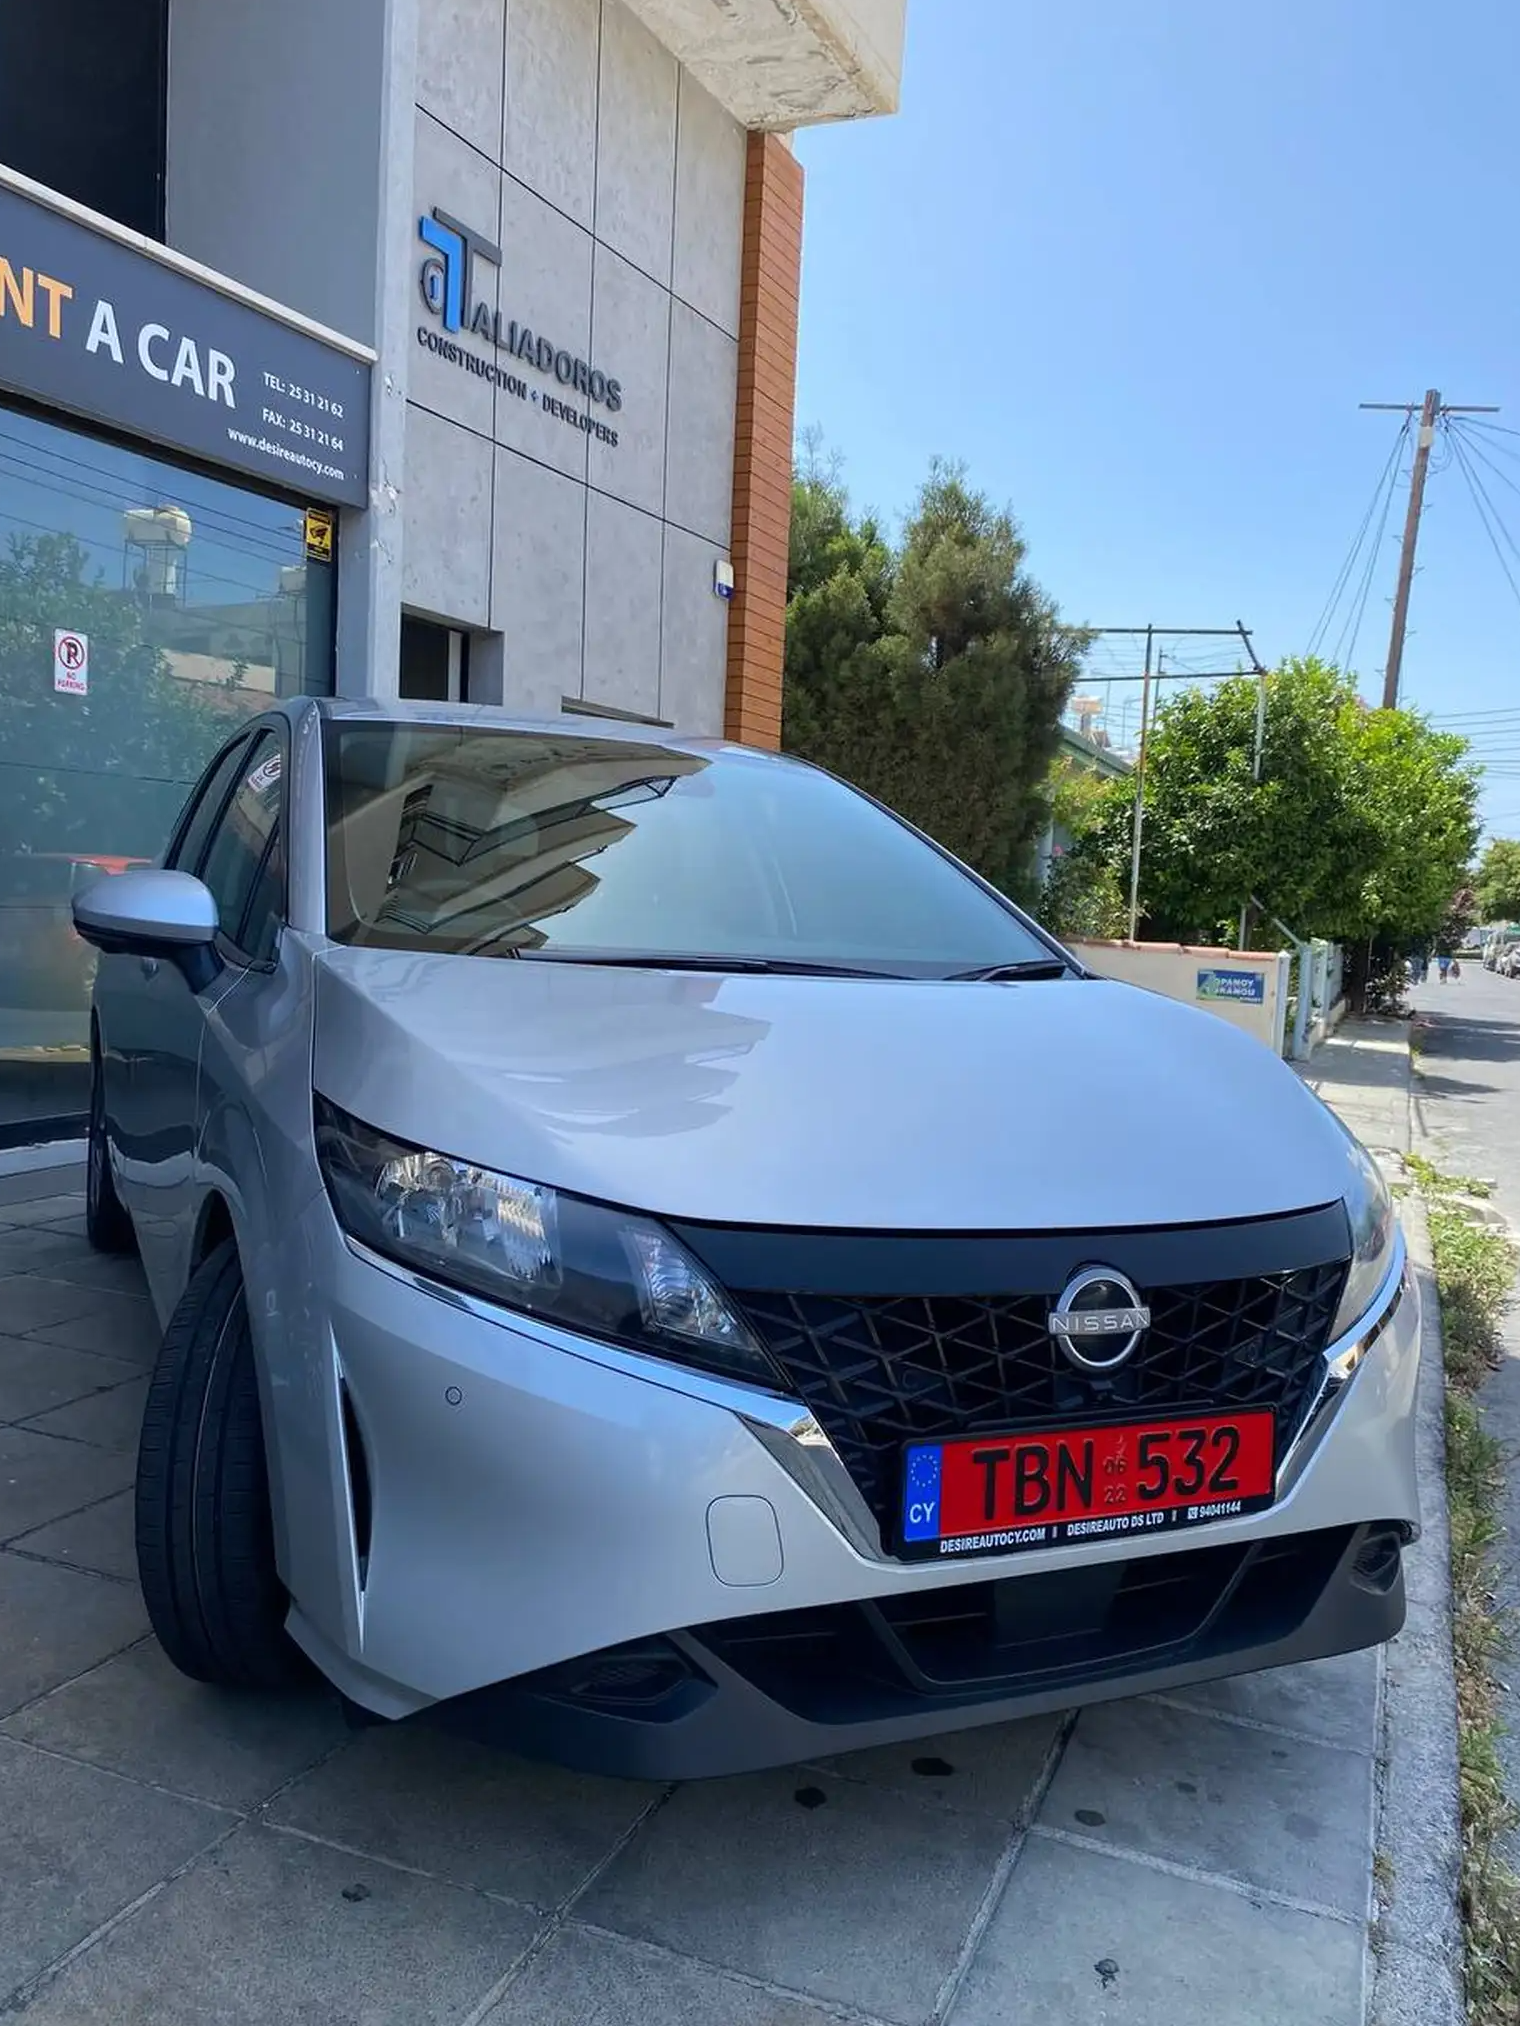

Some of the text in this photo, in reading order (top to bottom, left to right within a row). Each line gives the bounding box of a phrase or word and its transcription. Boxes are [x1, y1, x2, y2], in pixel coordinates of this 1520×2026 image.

[85, 299, 124, 365] A
[137, 323, 236, 410] CAR
[263, 371, 286, 393] TEL:
[417, 326, 528, 401] CONSTRUCTION
[542, 394, 619, 448] DEVELOPERS
[262, 408, 286, 428] FAX:
[227, 427, 345, 480] www.desireautocy.com
[1051, 1312, 1149, 1332] NISSAN
[973, 1425, 1241, 1520] TBN 532
[909, 1501, 935, 1524] CY
[940, 1500, 1242, 1554] DESIREAUTOCY.COM DESIREAUTO DS LTD 94041144
